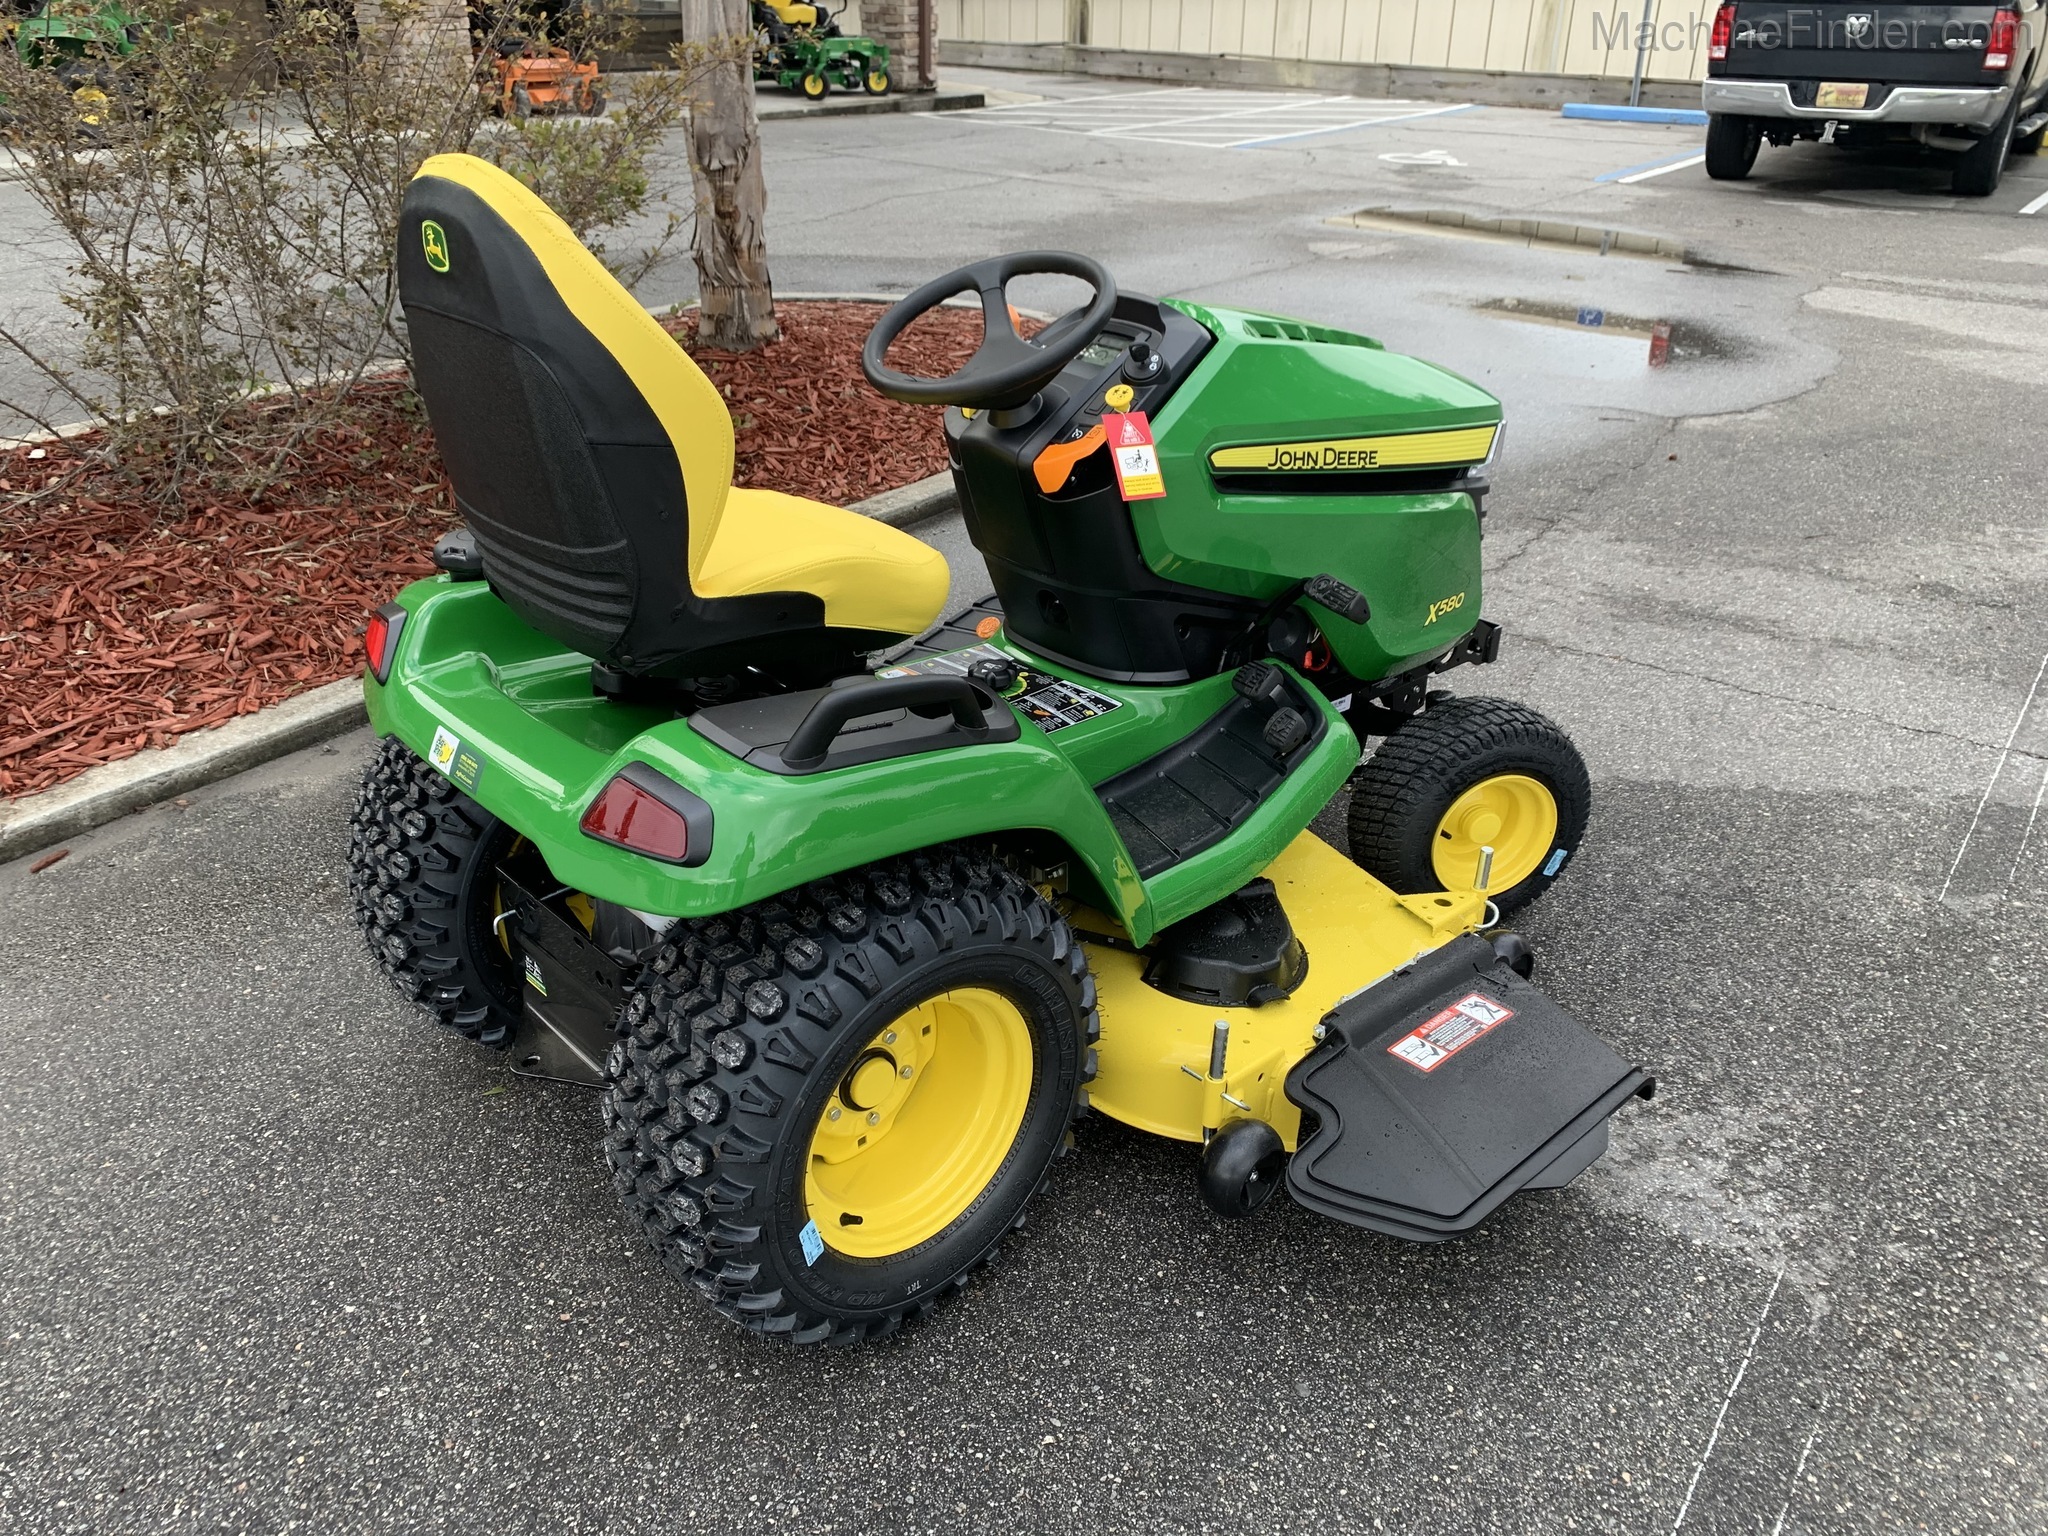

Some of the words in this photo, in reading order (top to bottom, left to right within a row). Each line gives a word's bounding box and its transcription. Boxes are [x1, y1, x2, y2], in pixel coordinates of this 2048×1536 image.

[1267, 447, 1319, 468] JOHN
[1323, 447, 1378, 468] DEERE
[1423, 591, 1466, 627] X580
[1014, 963, 1076, 1091] CARLISLE
[1427, 1010, 1454, 1030] DANGER
[905, 1278, 922, 1295] TRT
